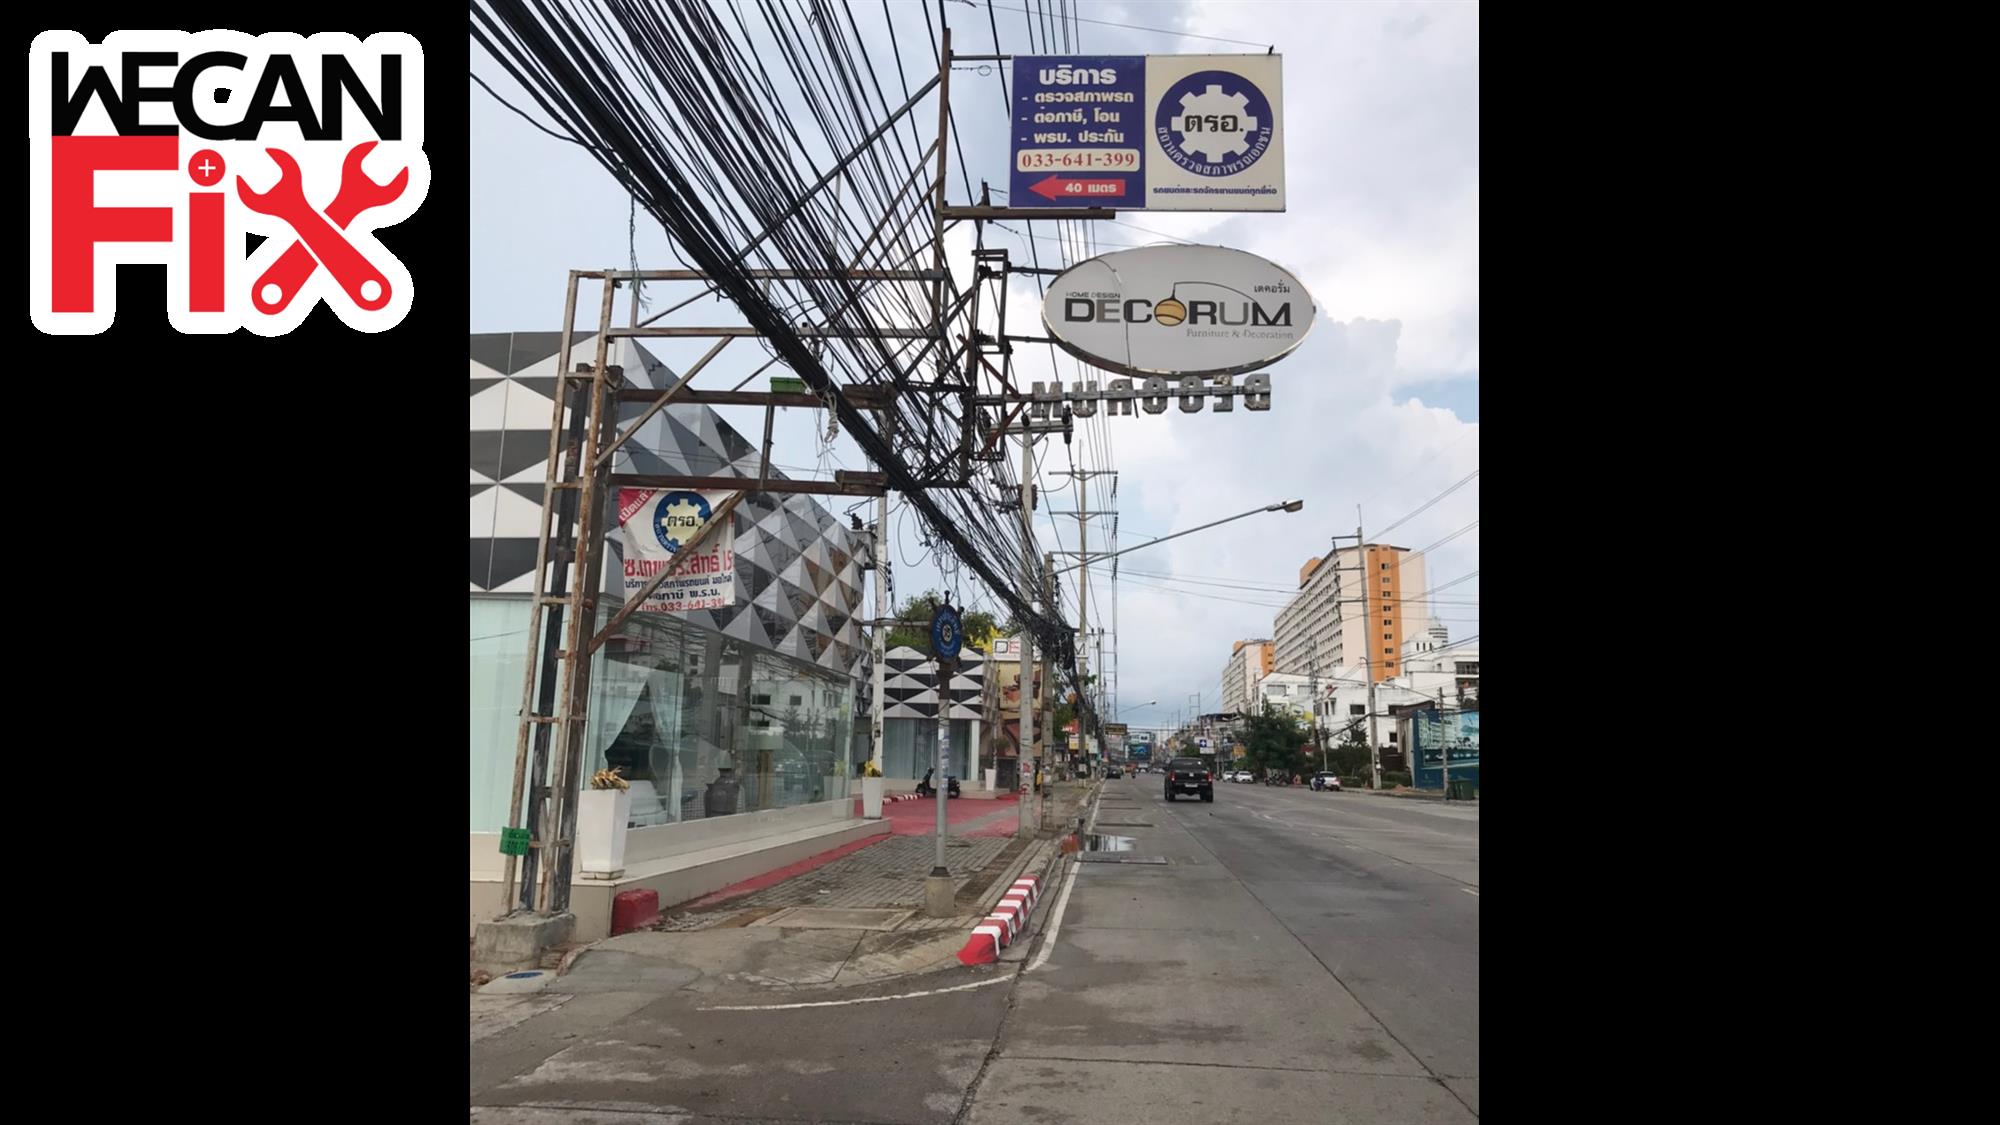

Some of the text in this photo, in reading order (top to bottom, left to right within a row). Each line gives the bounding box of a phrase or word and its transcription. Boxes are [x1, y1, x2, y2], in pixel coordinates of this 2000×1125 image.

[1039, 64, 1117, 85] บริการ
[1034, 91, 1134, 103] ตรวจสภาพรถ
[1094, 107, 1120, 123] โอน
[1184, 114, 1244, 133] ตรอ.
[1034, 128, 1124, 143] พรบ. ประกัน
[1022, 153, 1135, 168] 033-641-399
[1065, 183, 1117, 193] 40 เมตร
[1065, 297, 1293, 326] DECORUM
[1186, 328, 1230, 338] Furniture
[1244, 329, 1294, 339] Decoration
[667, 516, 699, 527] ตรอ.
[689, 588, 720, 598] พ.ร.บ.
